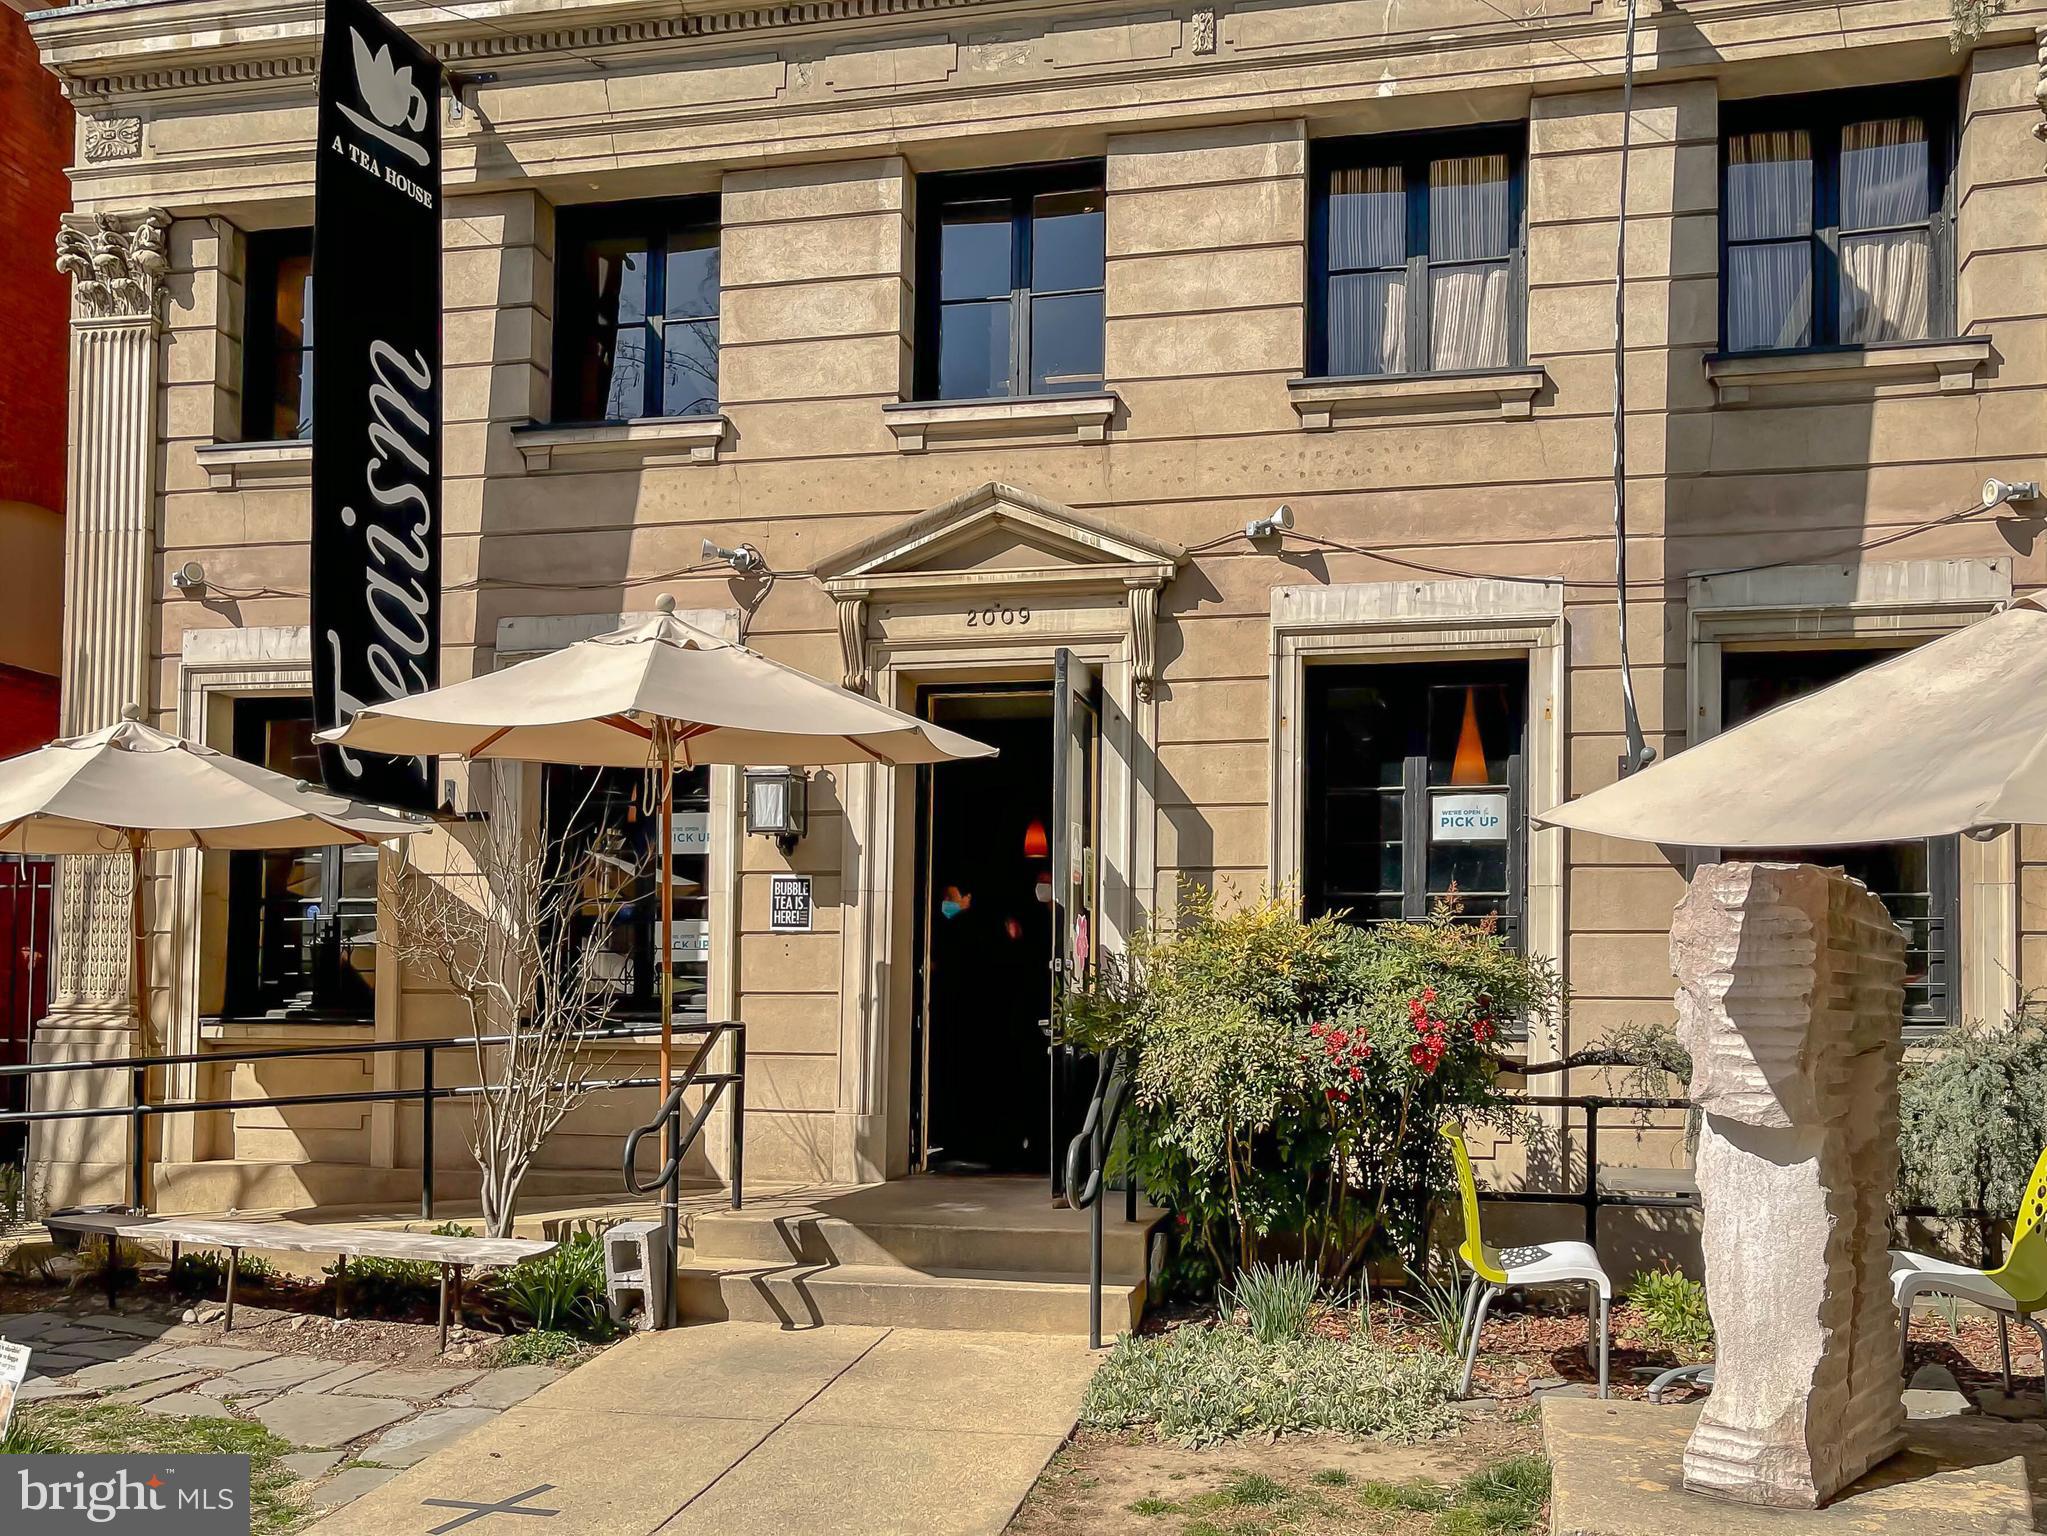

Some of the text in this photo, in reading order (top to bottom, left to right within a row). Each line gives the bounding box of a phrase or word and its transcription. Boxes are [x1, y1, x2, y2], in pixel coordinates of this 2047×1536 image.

[331, 135, 432, 209] A TEA HOUSE
[967, 607, 1030, 627] 2009
[1441, 816, 1499, 827] PICK UP
[774, 881, 809, 896] BUBBLE
[774, 896, 804, 910] TEA IS
[774, 910, 800, 924] HERE!
